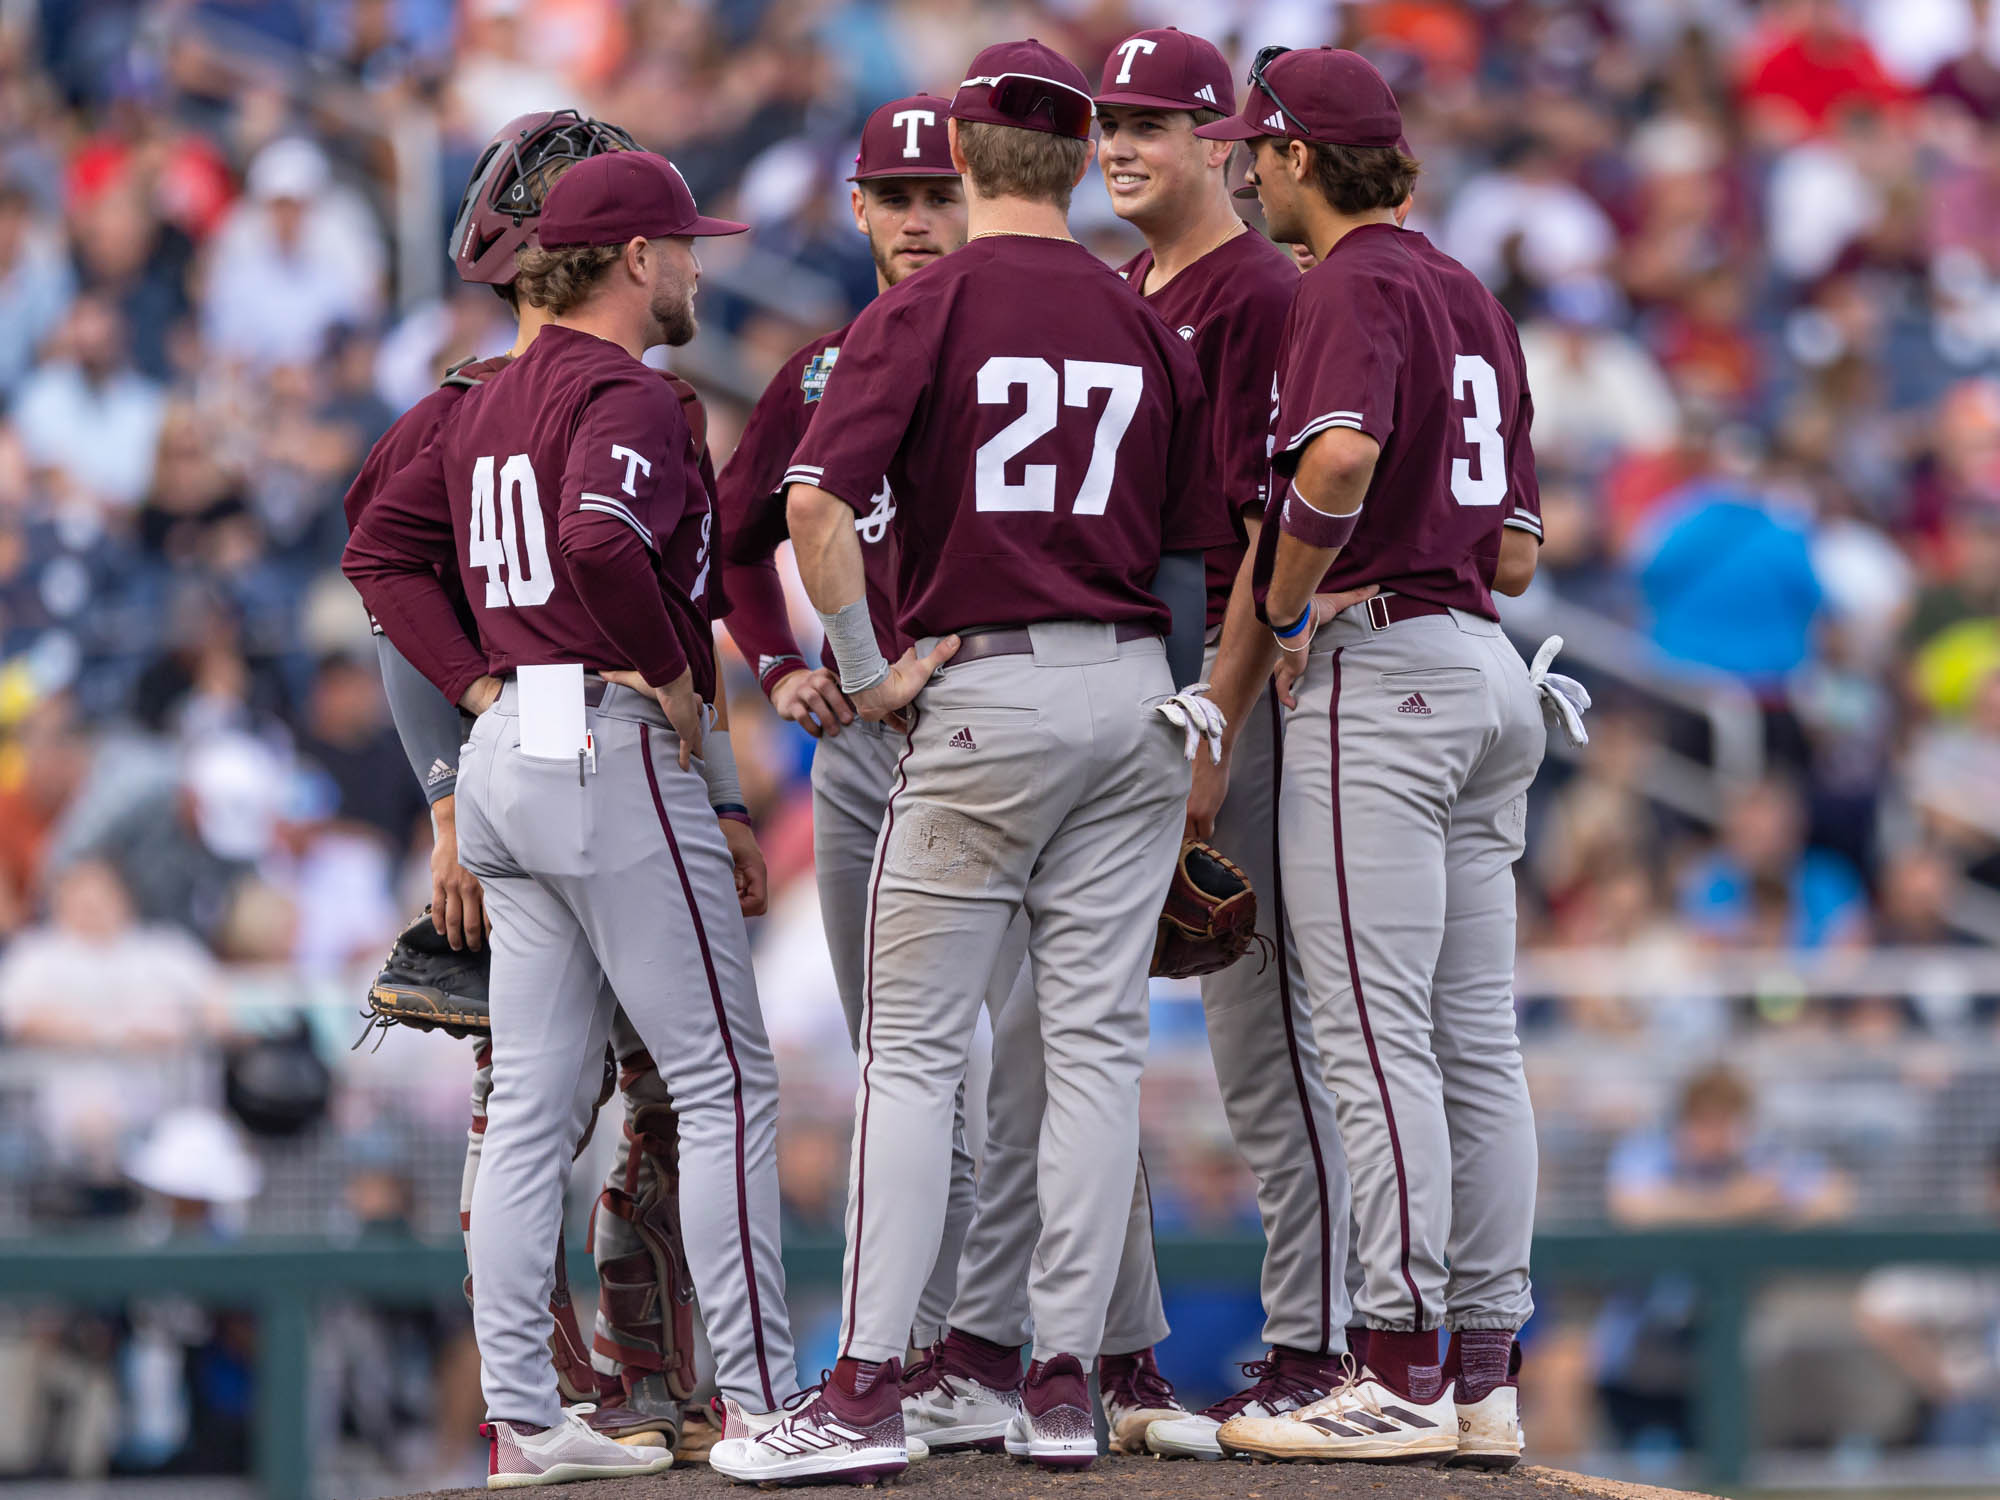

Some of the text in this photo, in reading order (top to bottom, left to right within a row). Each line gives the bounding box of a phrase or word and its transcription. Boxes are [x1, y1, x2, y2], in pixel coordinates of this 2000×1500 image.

[1116, 38, 1158, 84] T
[892, 109, 936, 159] T
[975, 356, 1144, 516] 27
[1450, 353, 1508, 507] 3
[610, 443, 652, 498] T
[468, 453, 556, 609] 40
[1397, 704, 1432, 715] adidas
[948, 739, 977, 750] adidas
[427, 767, 458, 786] adidas
